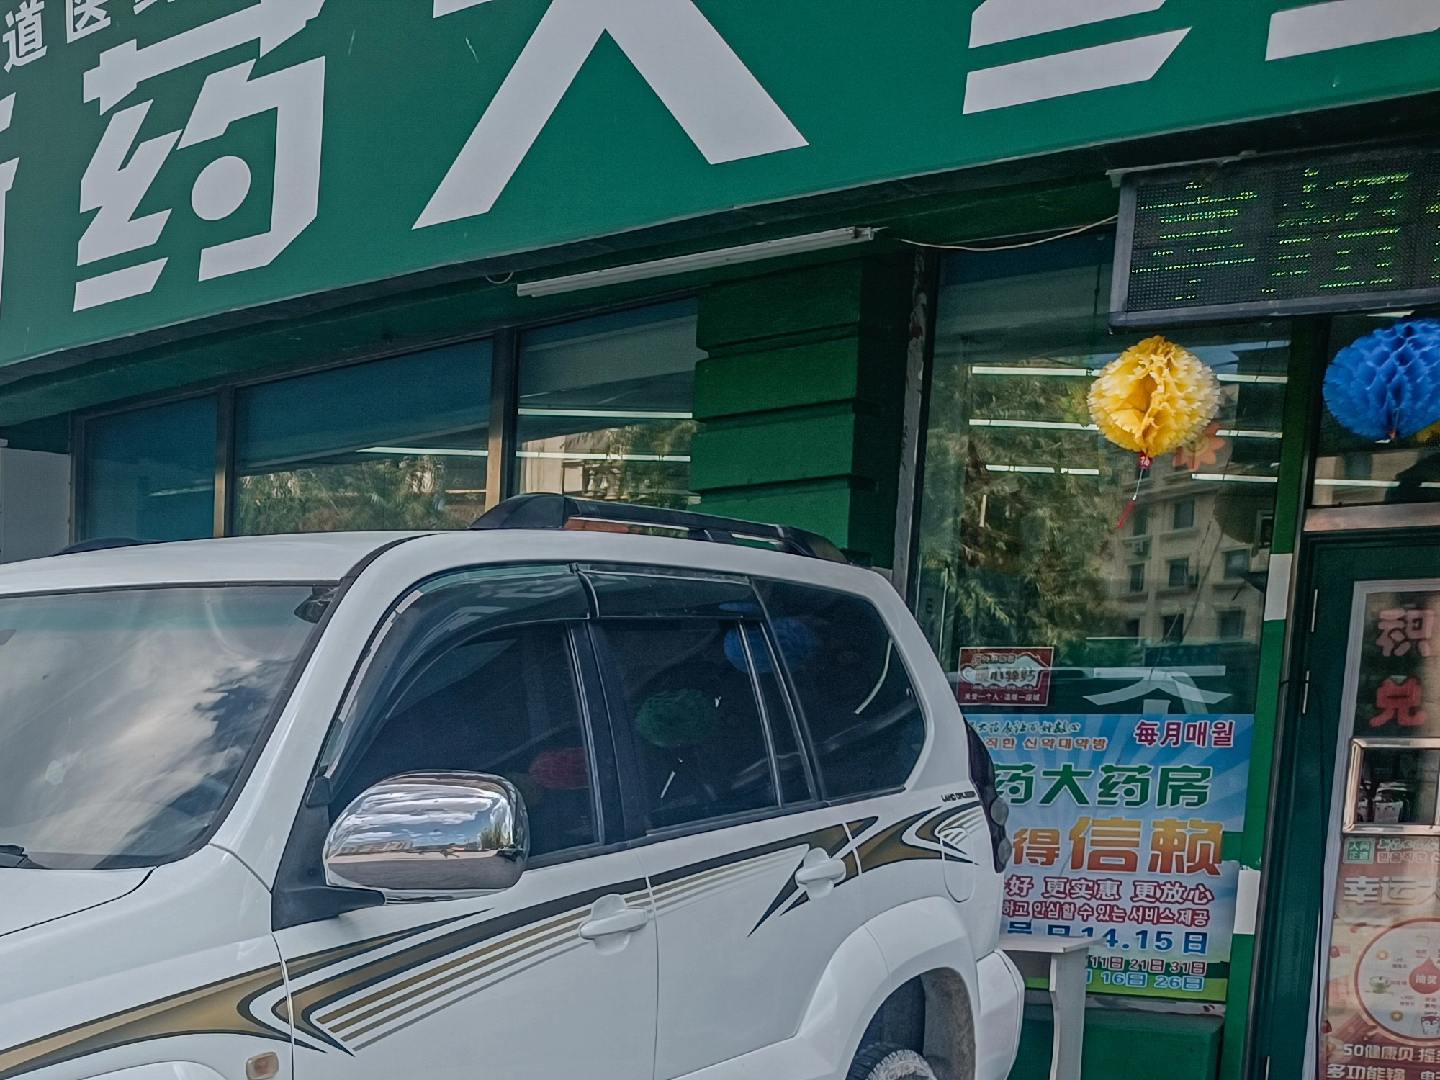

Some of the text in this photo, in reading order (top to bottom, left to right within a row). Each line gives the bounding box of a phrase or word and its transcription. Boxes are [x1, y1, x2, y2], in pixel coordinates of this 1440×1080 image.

[1369, 676, 1428, 728] 兑
[1013, 817, 1223, 876] 得信赖
[1043, 877, 1121, 901] 更实惠
[1131, 880, 1214, 905] 更放心
